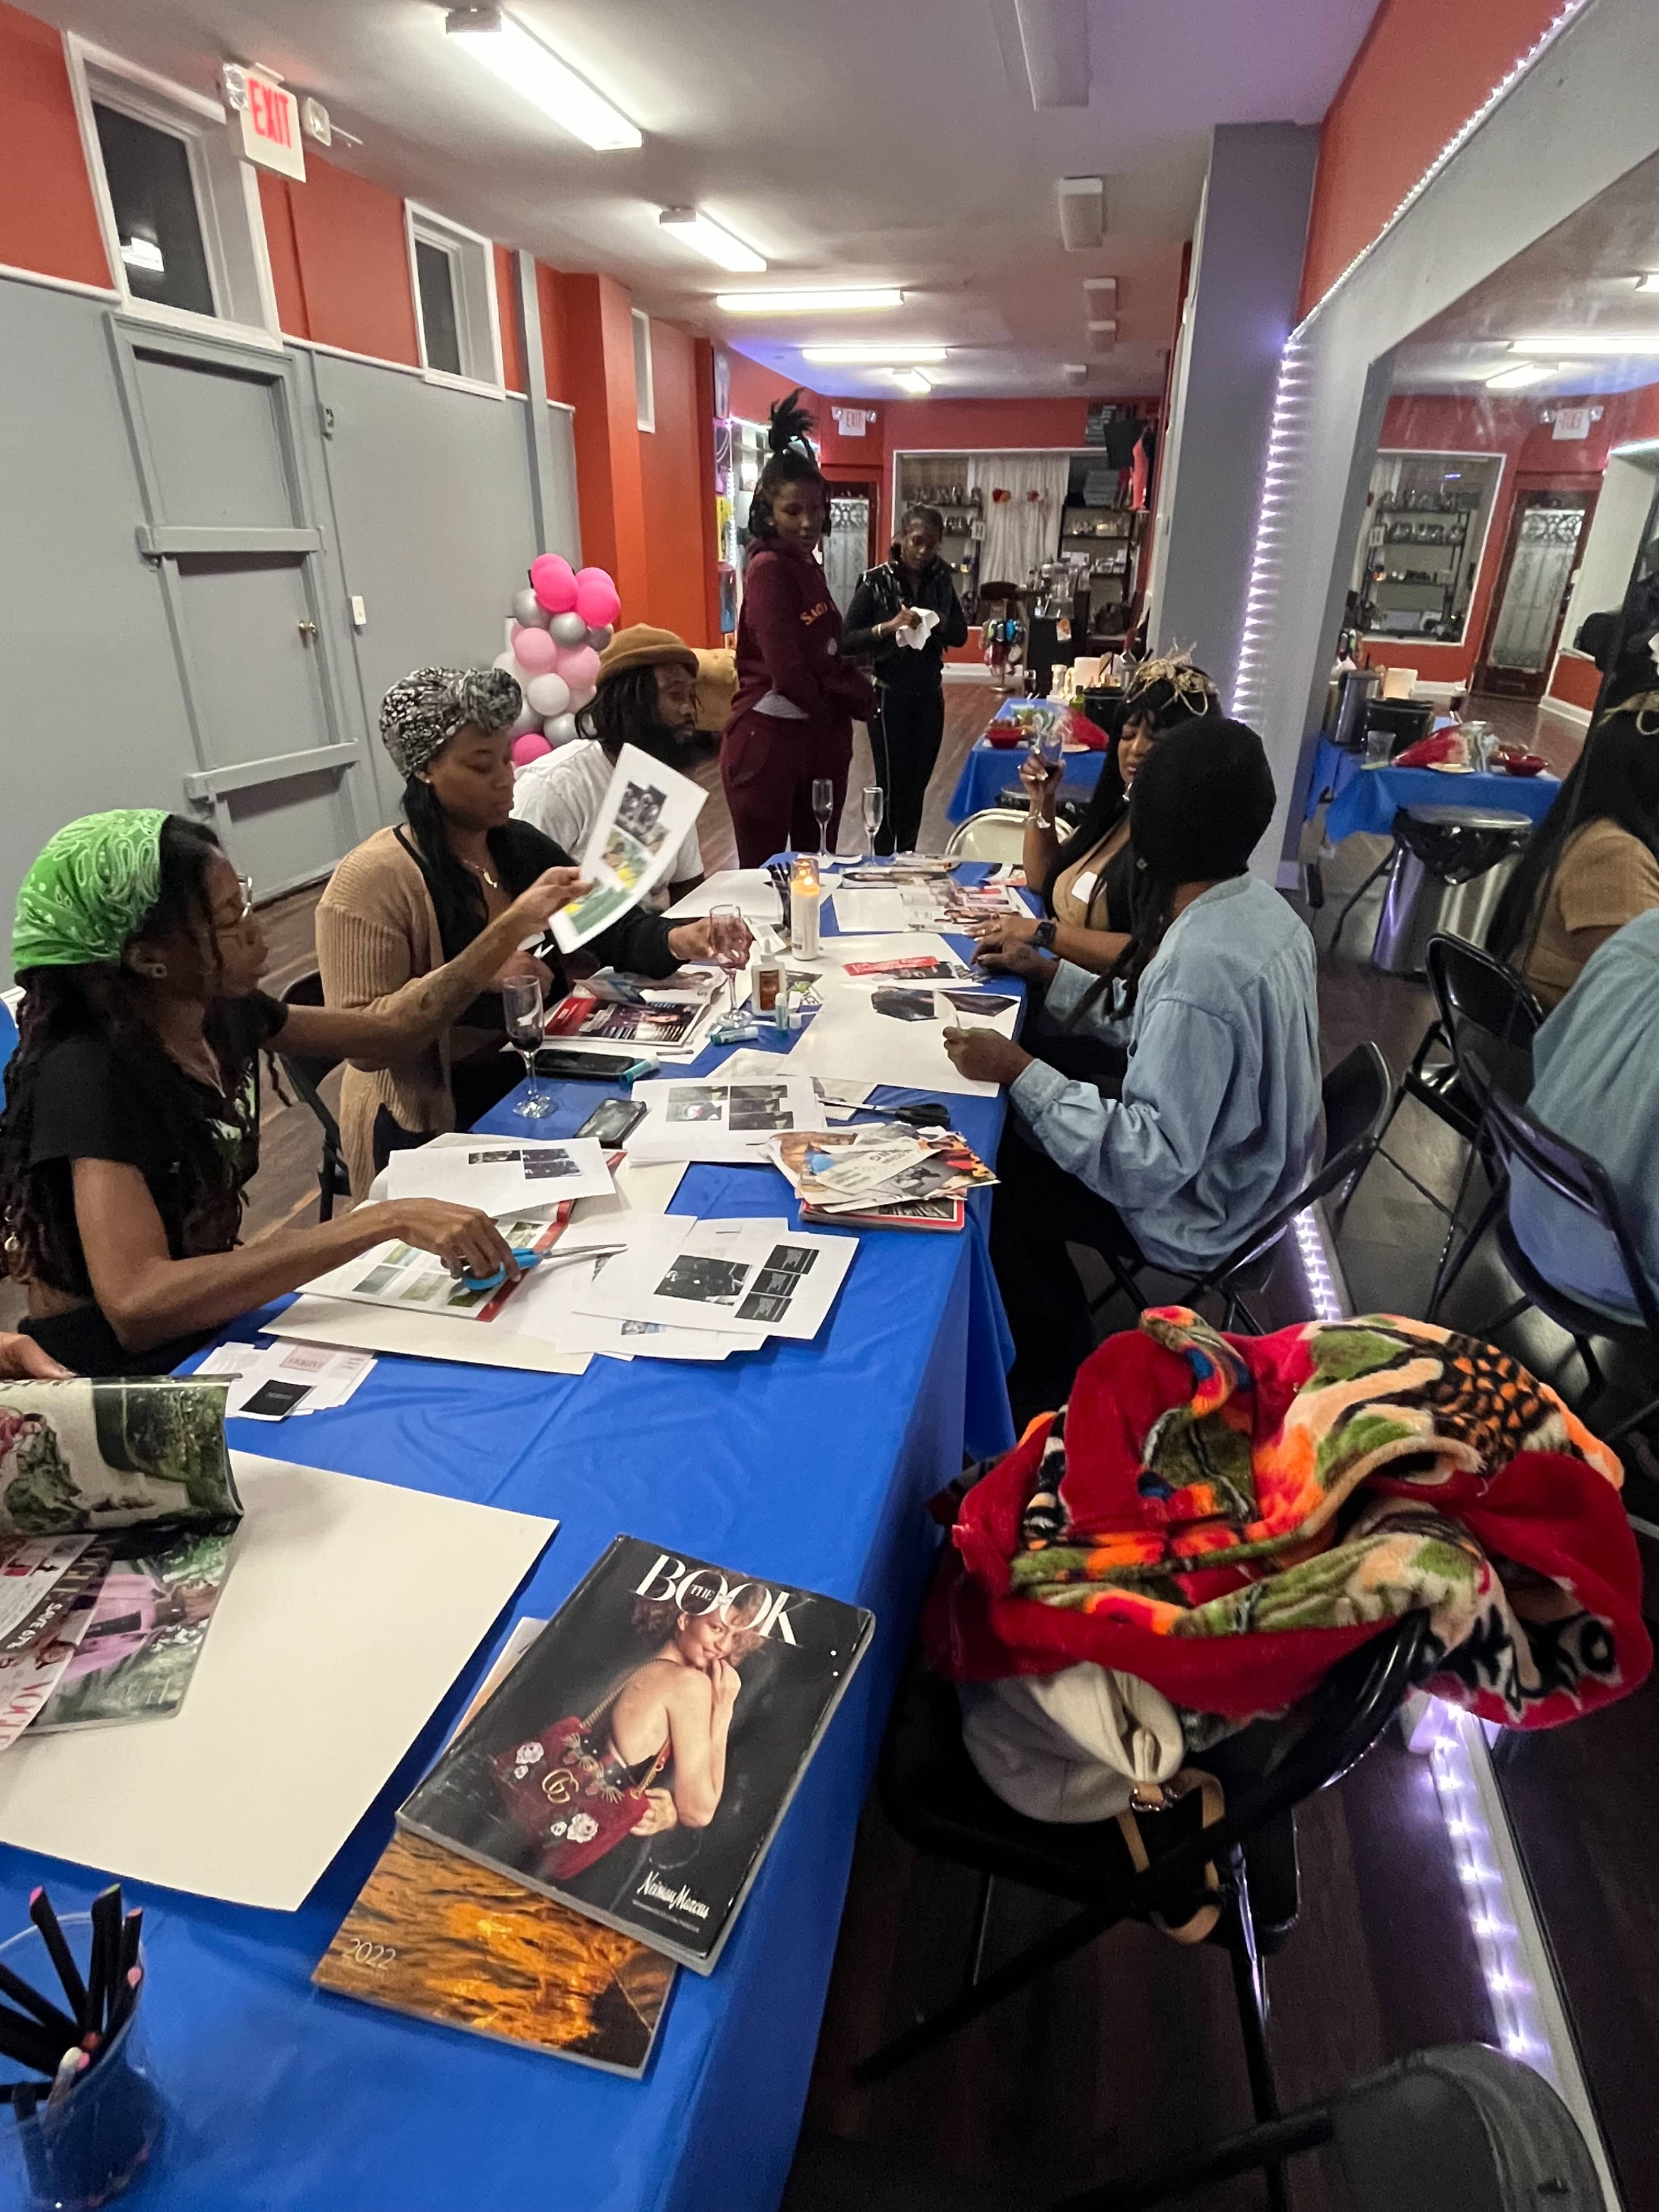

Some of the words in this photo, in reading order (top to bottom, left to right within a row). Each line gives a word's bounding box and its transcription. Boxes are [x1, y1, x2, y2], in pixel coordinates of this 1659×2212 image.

[248, 78, 292, 149] EXIT
[845, 410, 862, 428] EXIT
[629, 1553, 816, 1647] BOOK
[690, 1584, 715, 1601] THE
[29, 1602, 63, 1628] SAVE
[341, 1938, 396, 1970] 2022
